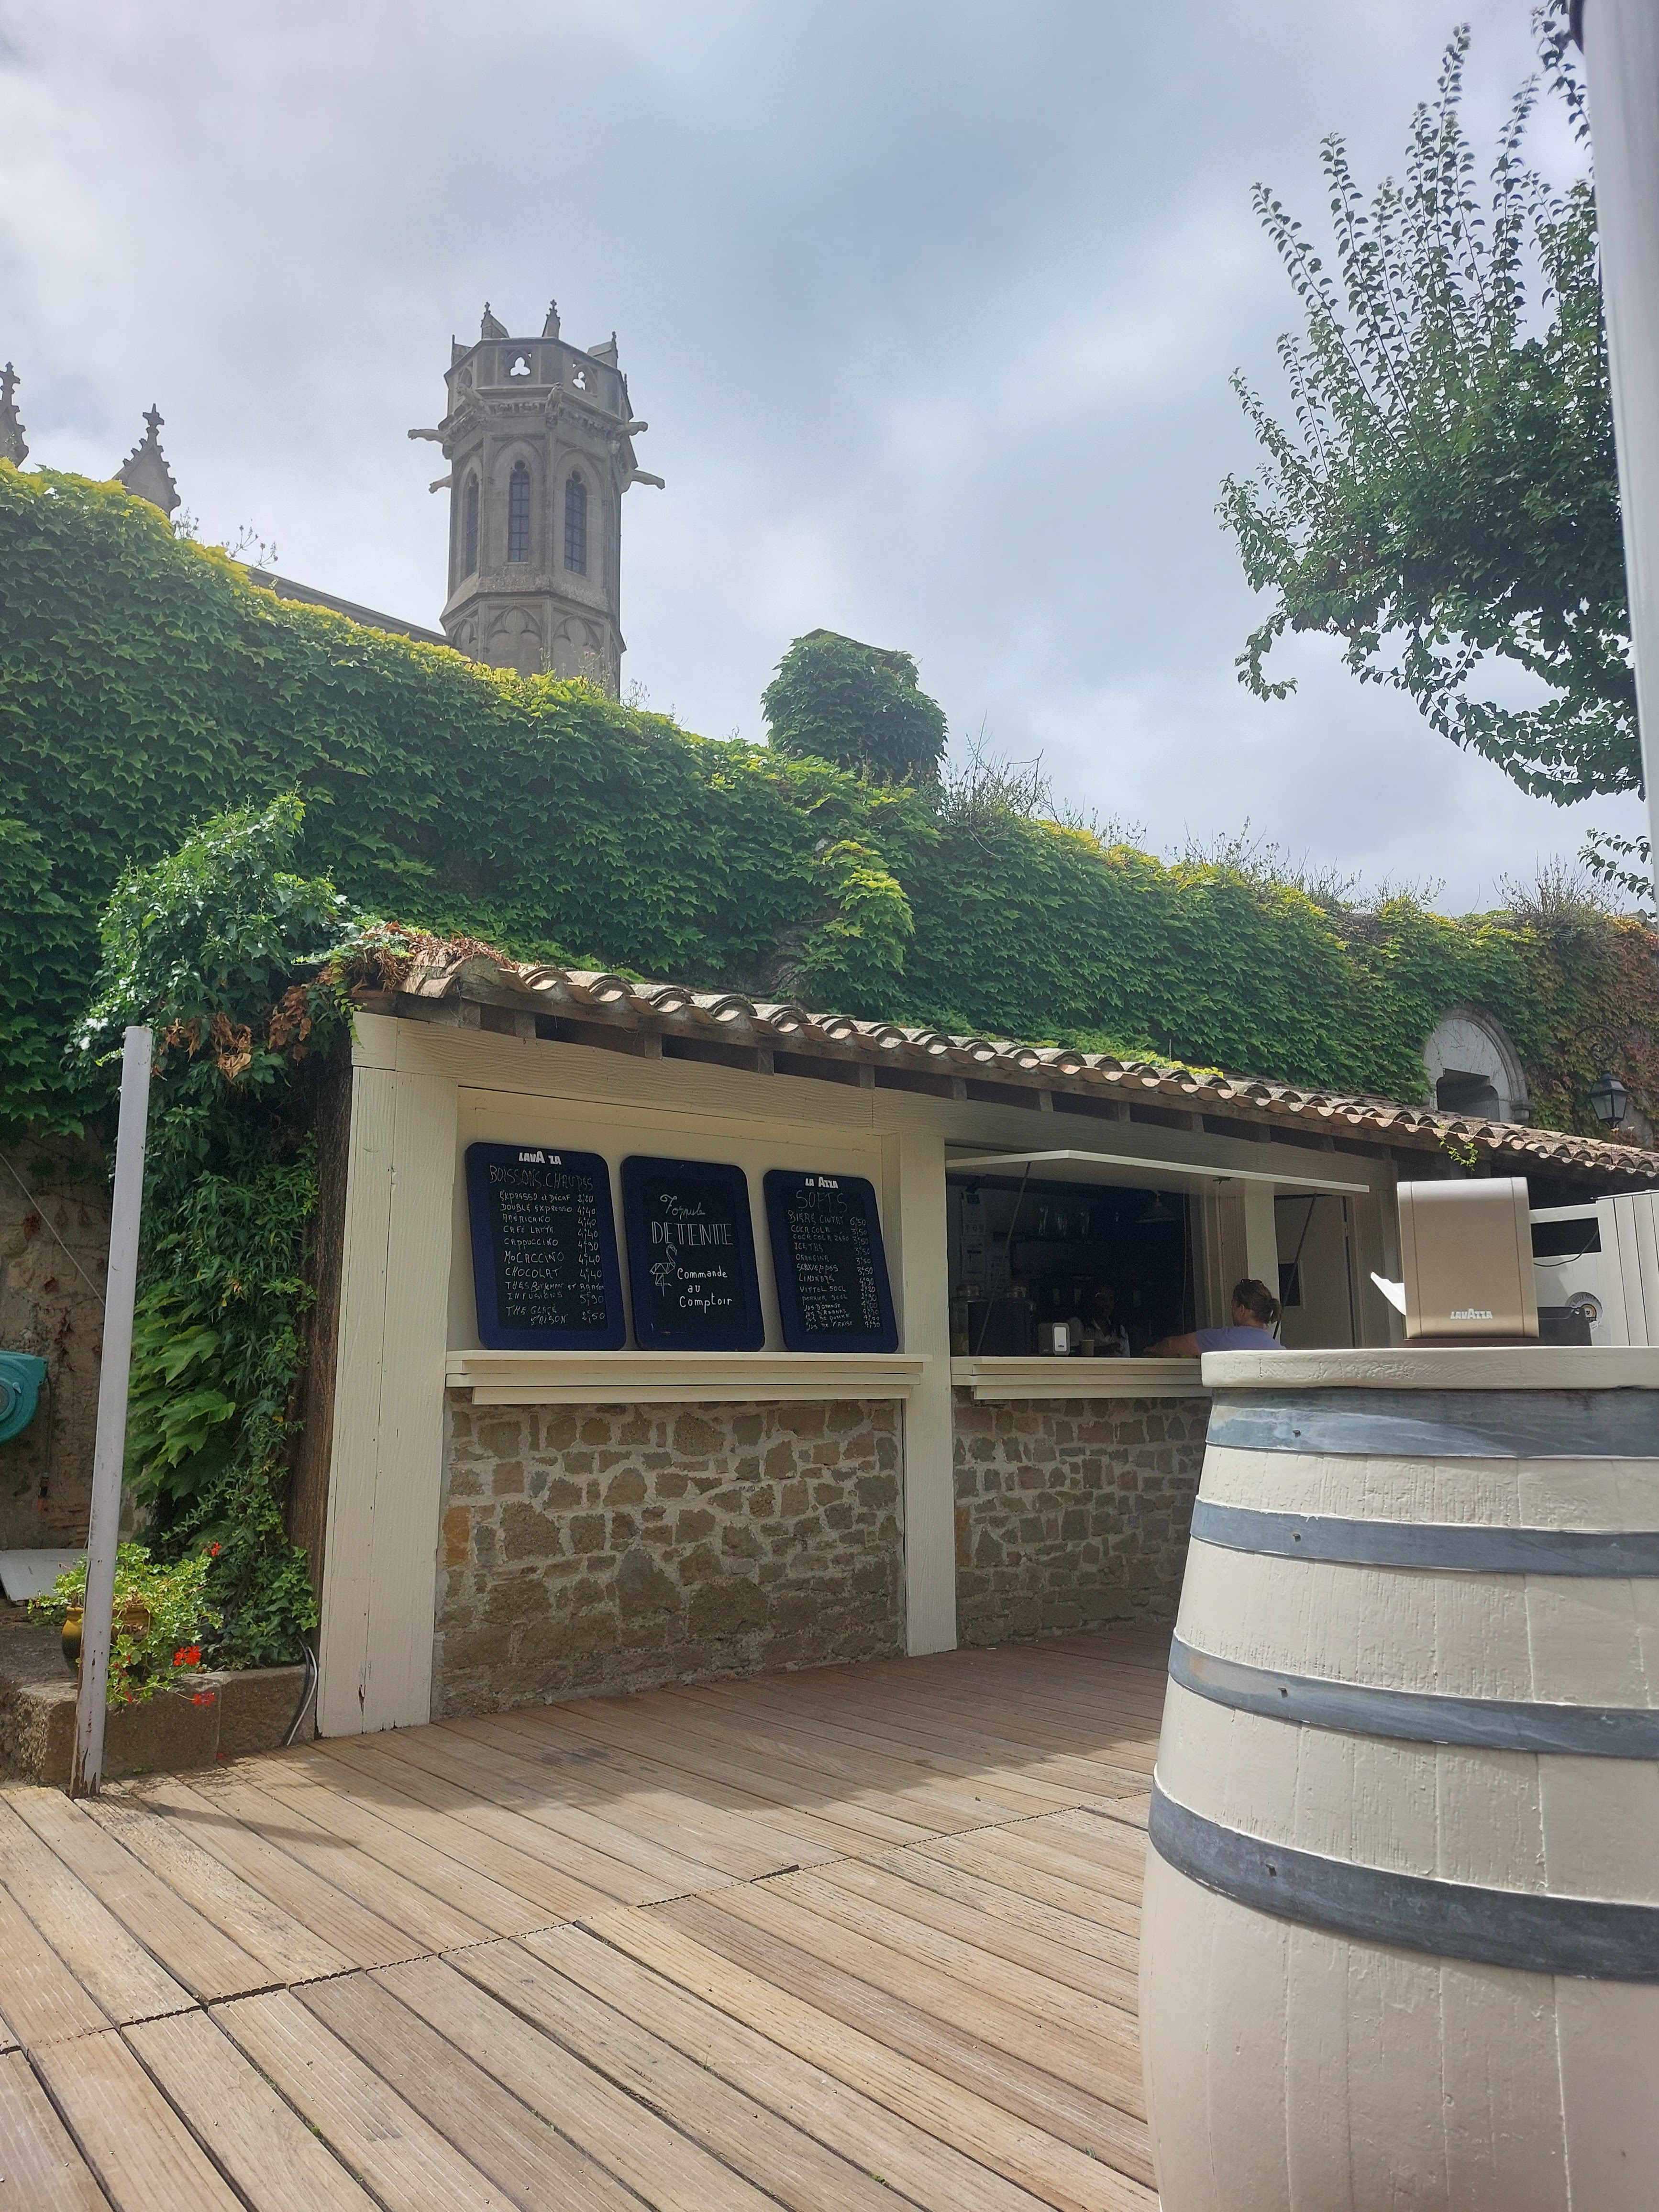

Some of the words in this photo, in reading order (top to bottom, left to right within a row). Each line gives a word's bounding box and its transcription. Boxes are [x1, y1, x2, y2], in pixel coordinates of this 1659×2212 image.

[796, 1190, 847, 1213] SOFTS
[652, 1221, 733, 1245] DETENTE
[791, 1225, 809, 1233] COCA
[505, 1266, 562, 1279] CHOCOLAT
[677, 1265, 728, 1279] Commande
[508, 1292, 562, 1300] INFUSIONS
[679, 1292, 732, 1314] Comptoir
[1450, 1308, 1493, 1319] LAVAZZA
